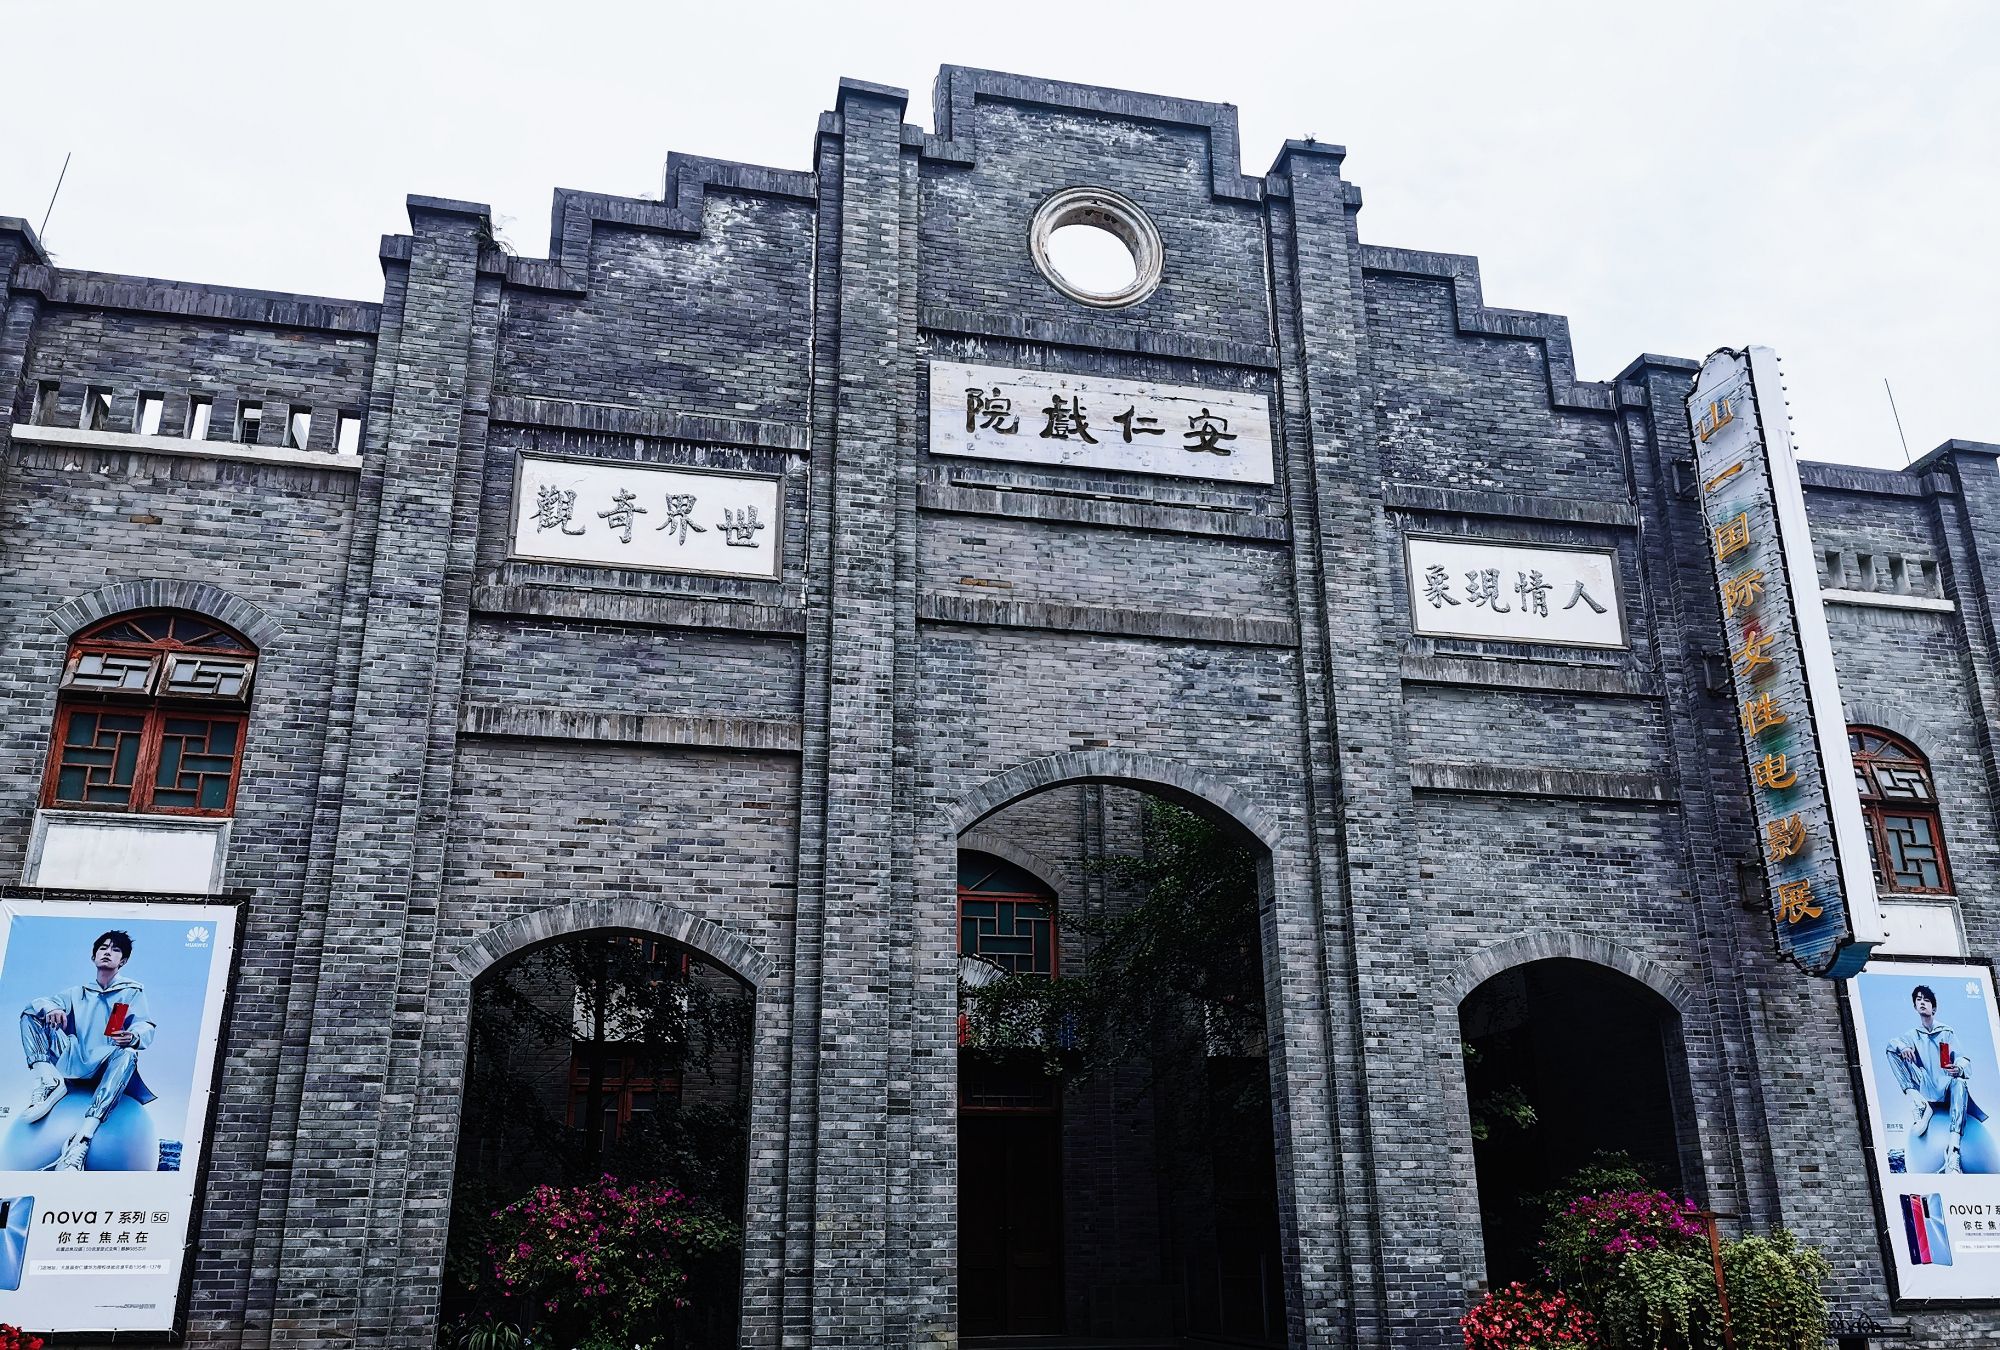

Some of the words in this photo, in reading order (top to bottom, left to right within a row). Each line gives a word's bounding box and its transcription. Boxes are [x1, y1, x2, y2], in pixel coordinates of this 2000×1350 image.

[1699, 399, 1824, 924] 山一国际女性电影展
[1949, 1204, 1983, 1215] nova
[1985, 1204, 1991, 1215] 7
[41, 1211, 98, 1224] nova
[104, 1211, 114, 1224] 7
[118, 1211, 146, 1224] 系列
[152, 1212, 168, 1223] 5G
